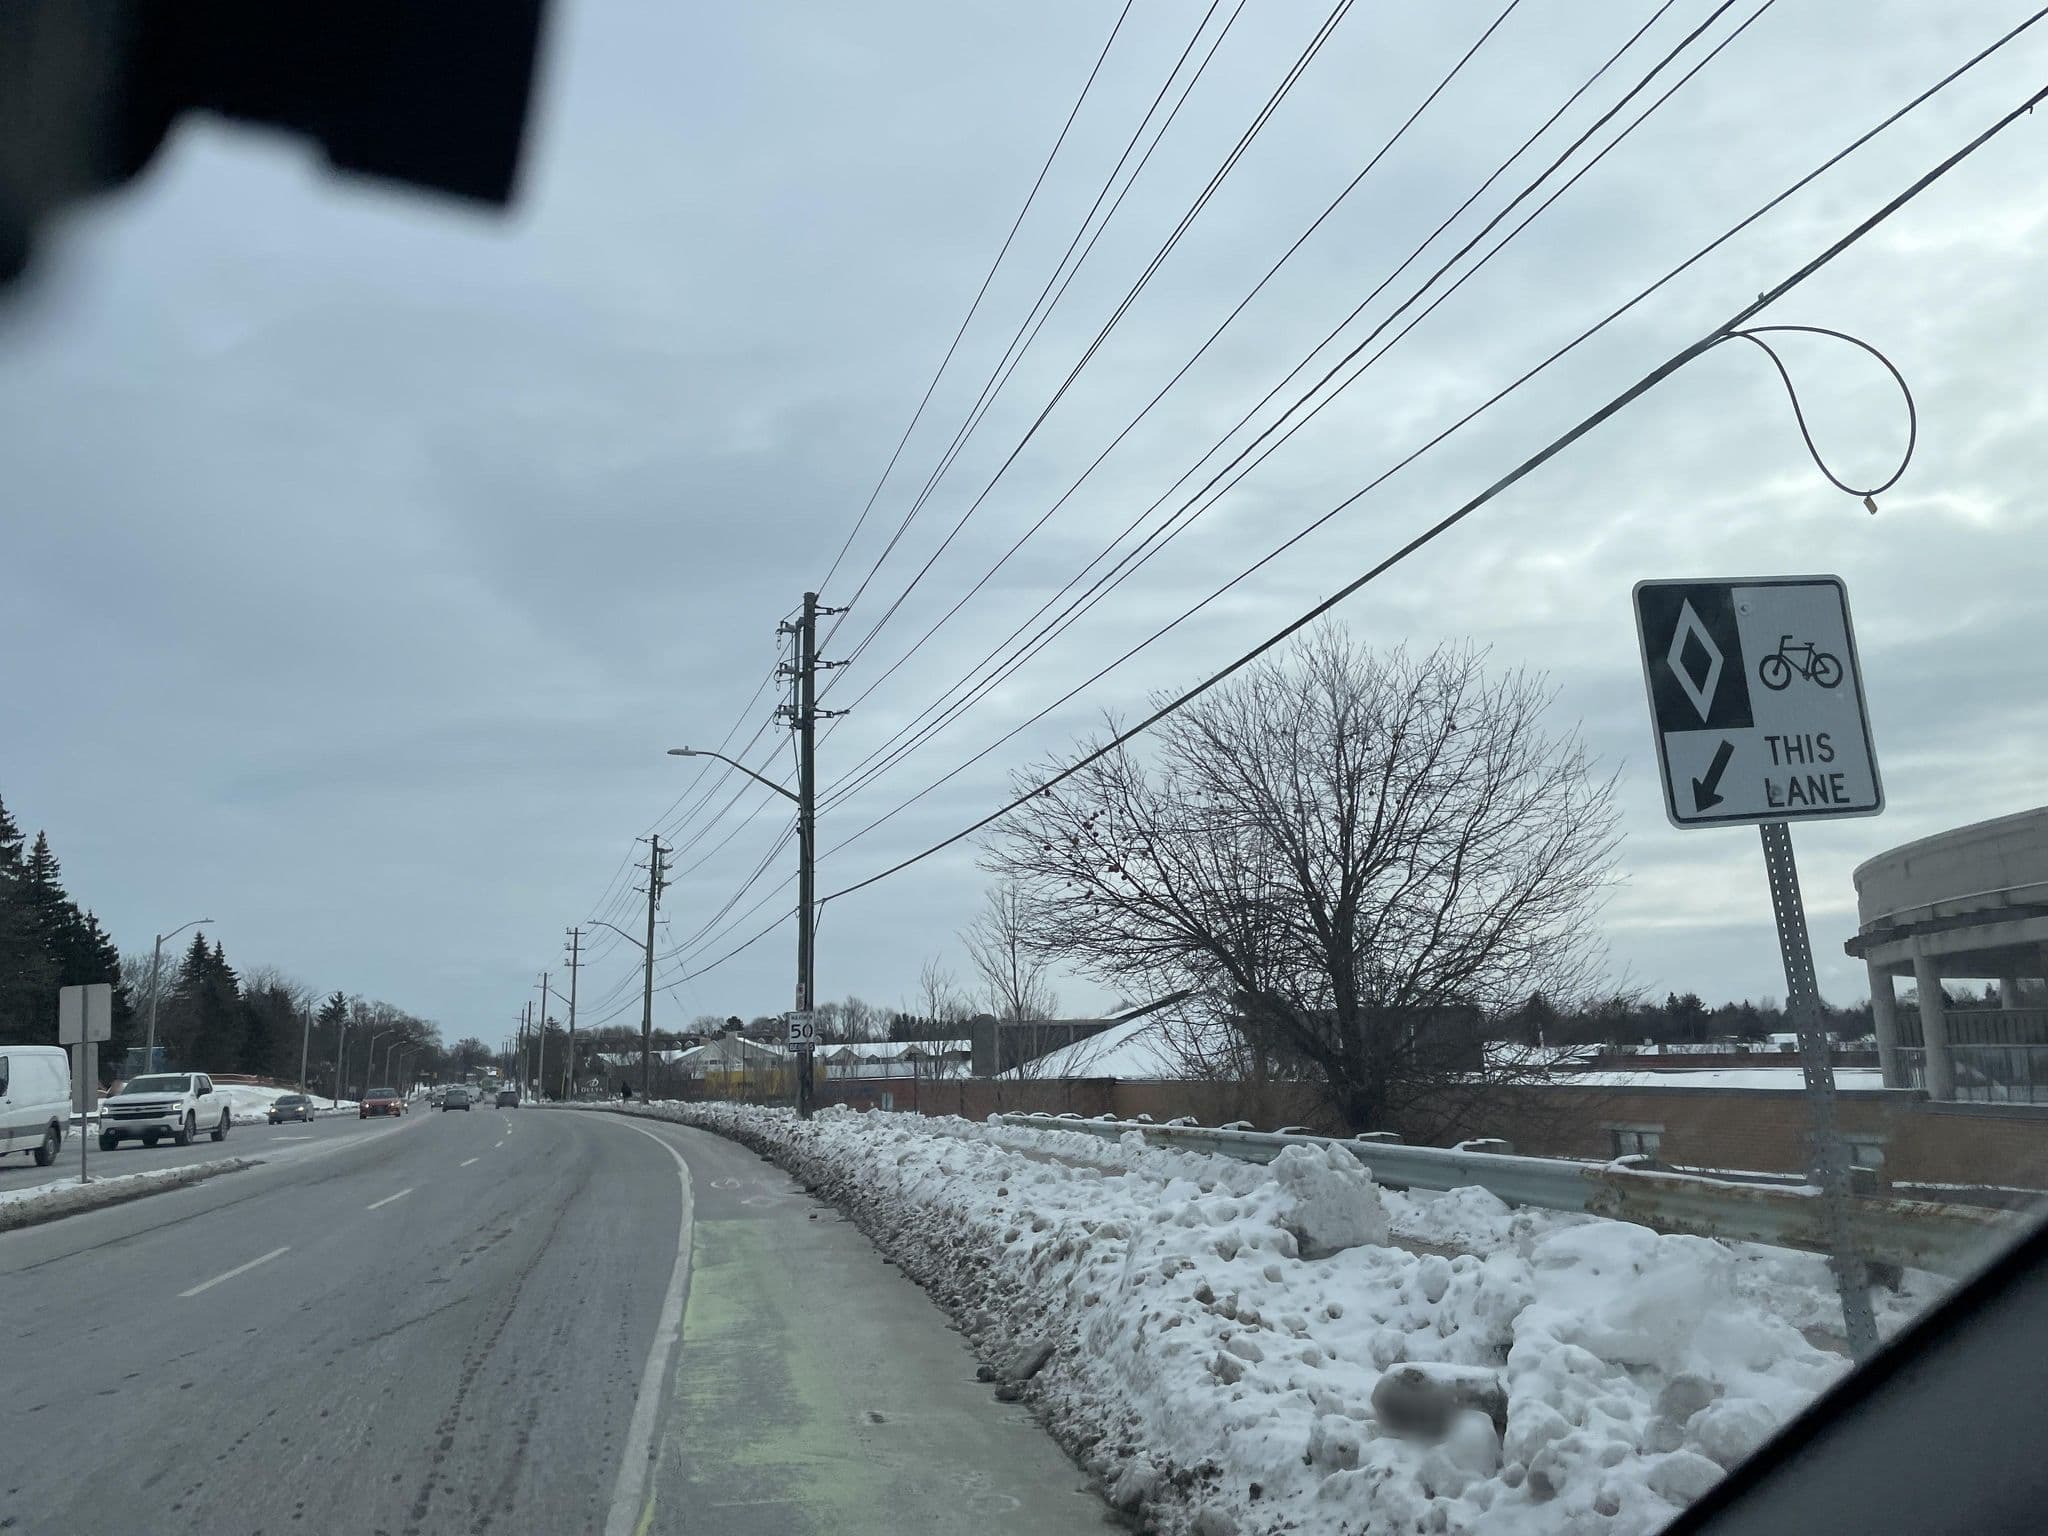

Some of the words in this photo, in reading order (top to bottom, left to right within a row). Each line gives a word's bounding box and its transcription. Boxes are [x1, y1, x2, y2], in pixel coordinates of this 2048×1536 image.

[1764, 733, 1835, 766] THIS
[1764, 773, 1850, 808] LANE
[791, 1023, 813, 1039] 50
